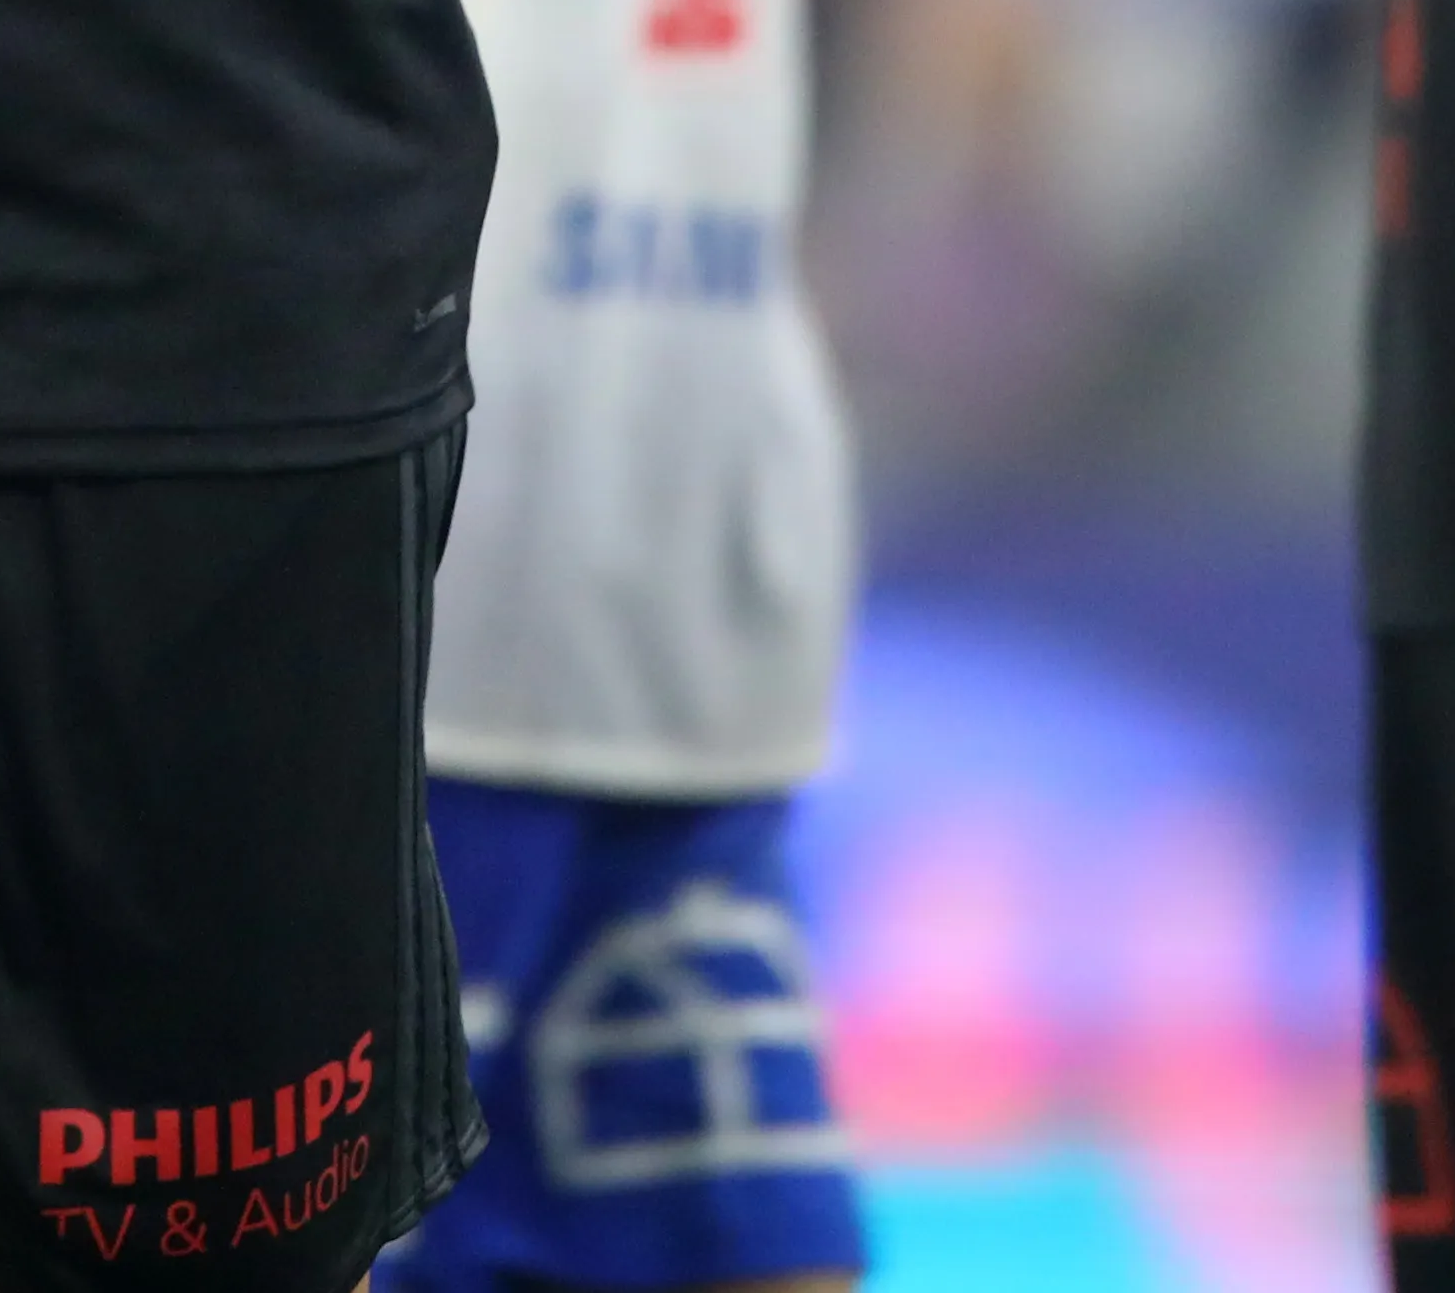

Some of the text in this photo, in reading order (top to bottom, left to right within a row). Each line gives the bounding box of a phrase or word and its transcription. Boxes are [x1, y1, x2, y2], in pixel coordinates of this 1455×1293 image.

[38, 1030, 374, 1186] PHILIPS
[40, 1134, 371, 1262] TV & Audio
